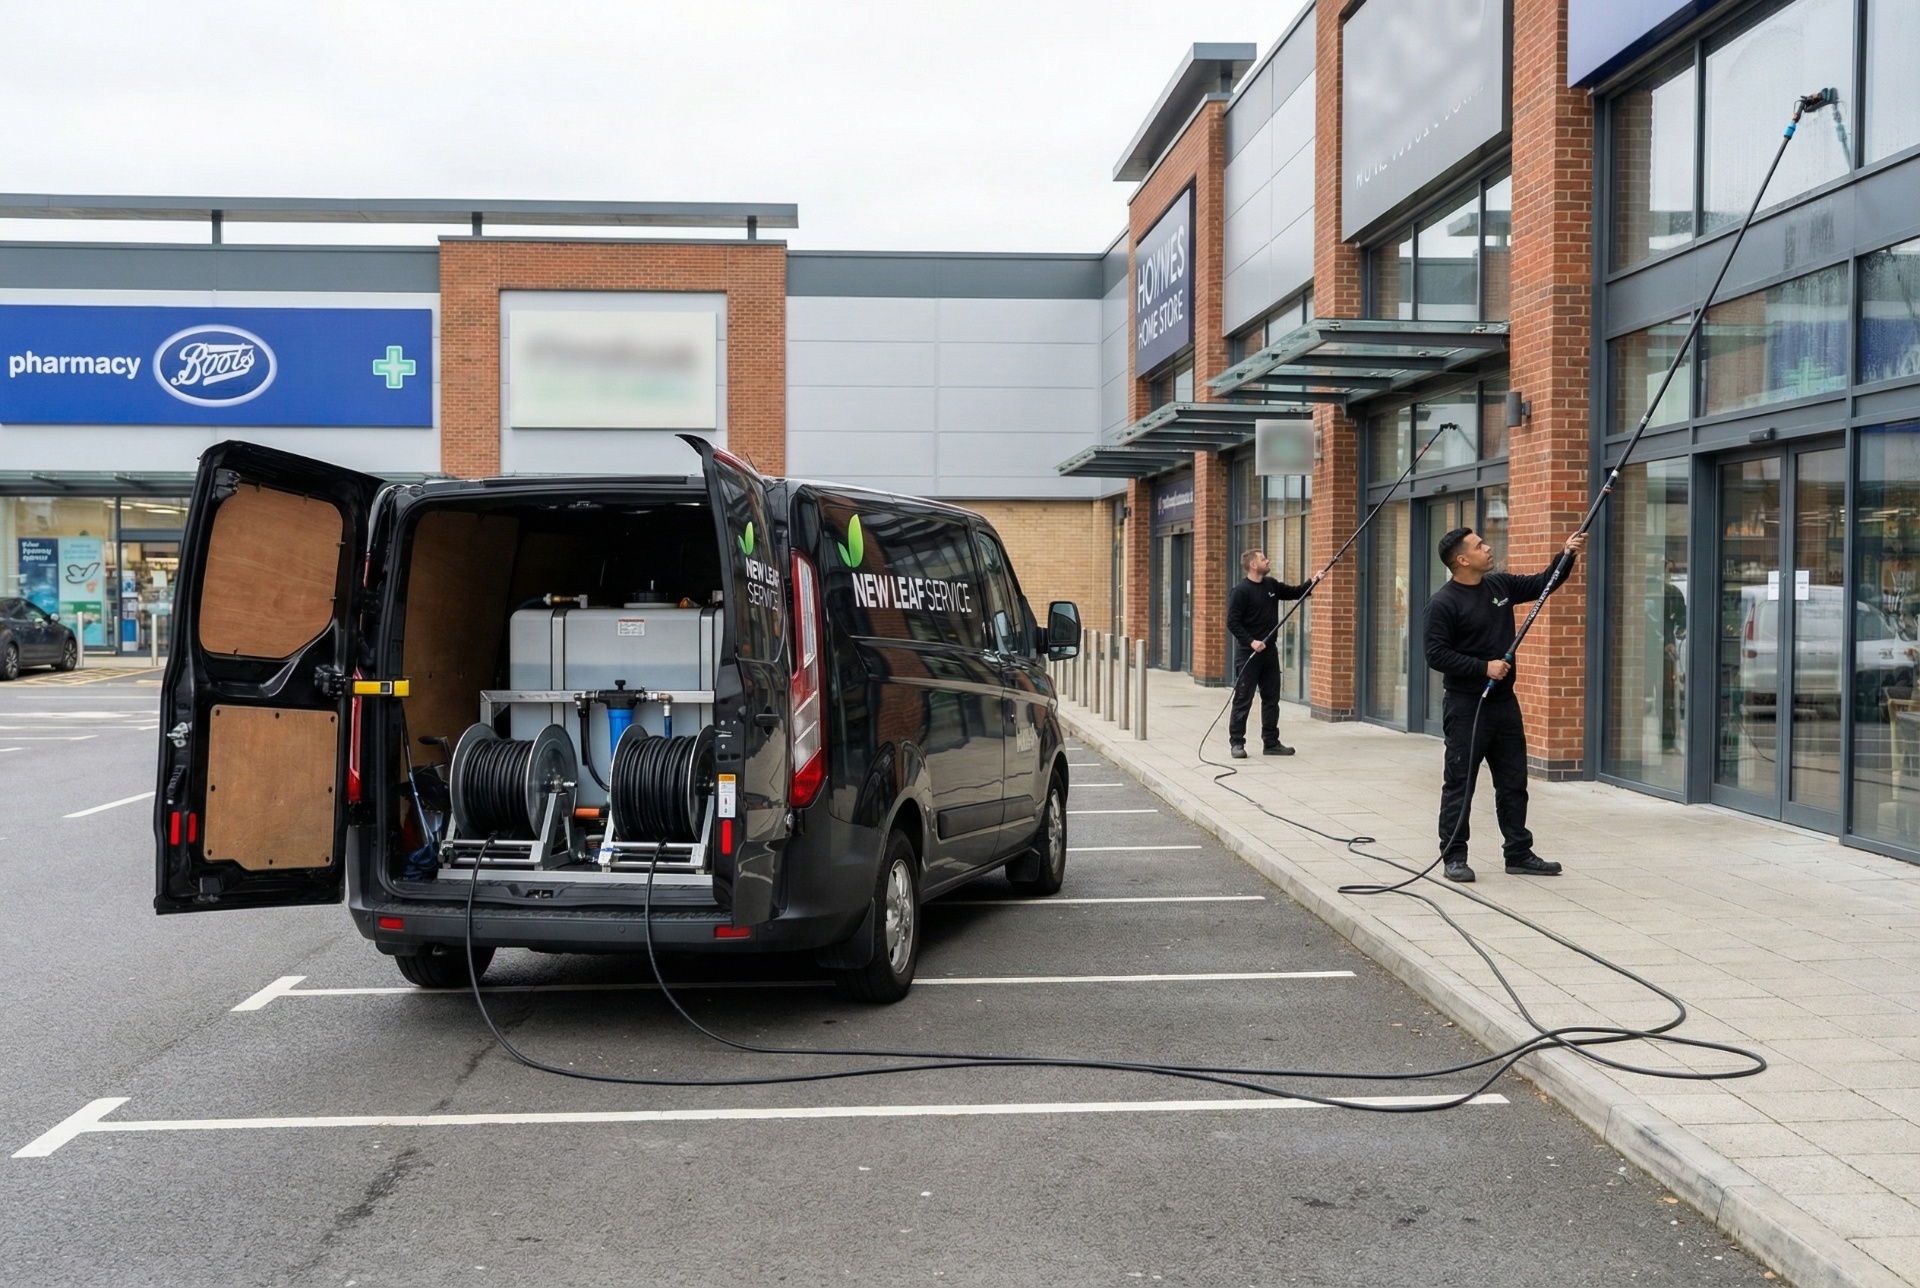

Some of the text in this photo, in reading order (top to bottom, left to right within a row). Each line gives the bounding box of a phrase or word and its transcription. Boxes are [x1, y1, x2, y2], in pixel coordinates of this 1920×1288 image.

[1159, 289, 1184, 335] STORE
[9, 350, 141, 379] pharmacy
[170, 342, 256, 386] Boots
[745, 557, 764, 582] NEW
[852, 573, 972, 613] NEW LEAF SERVICE
